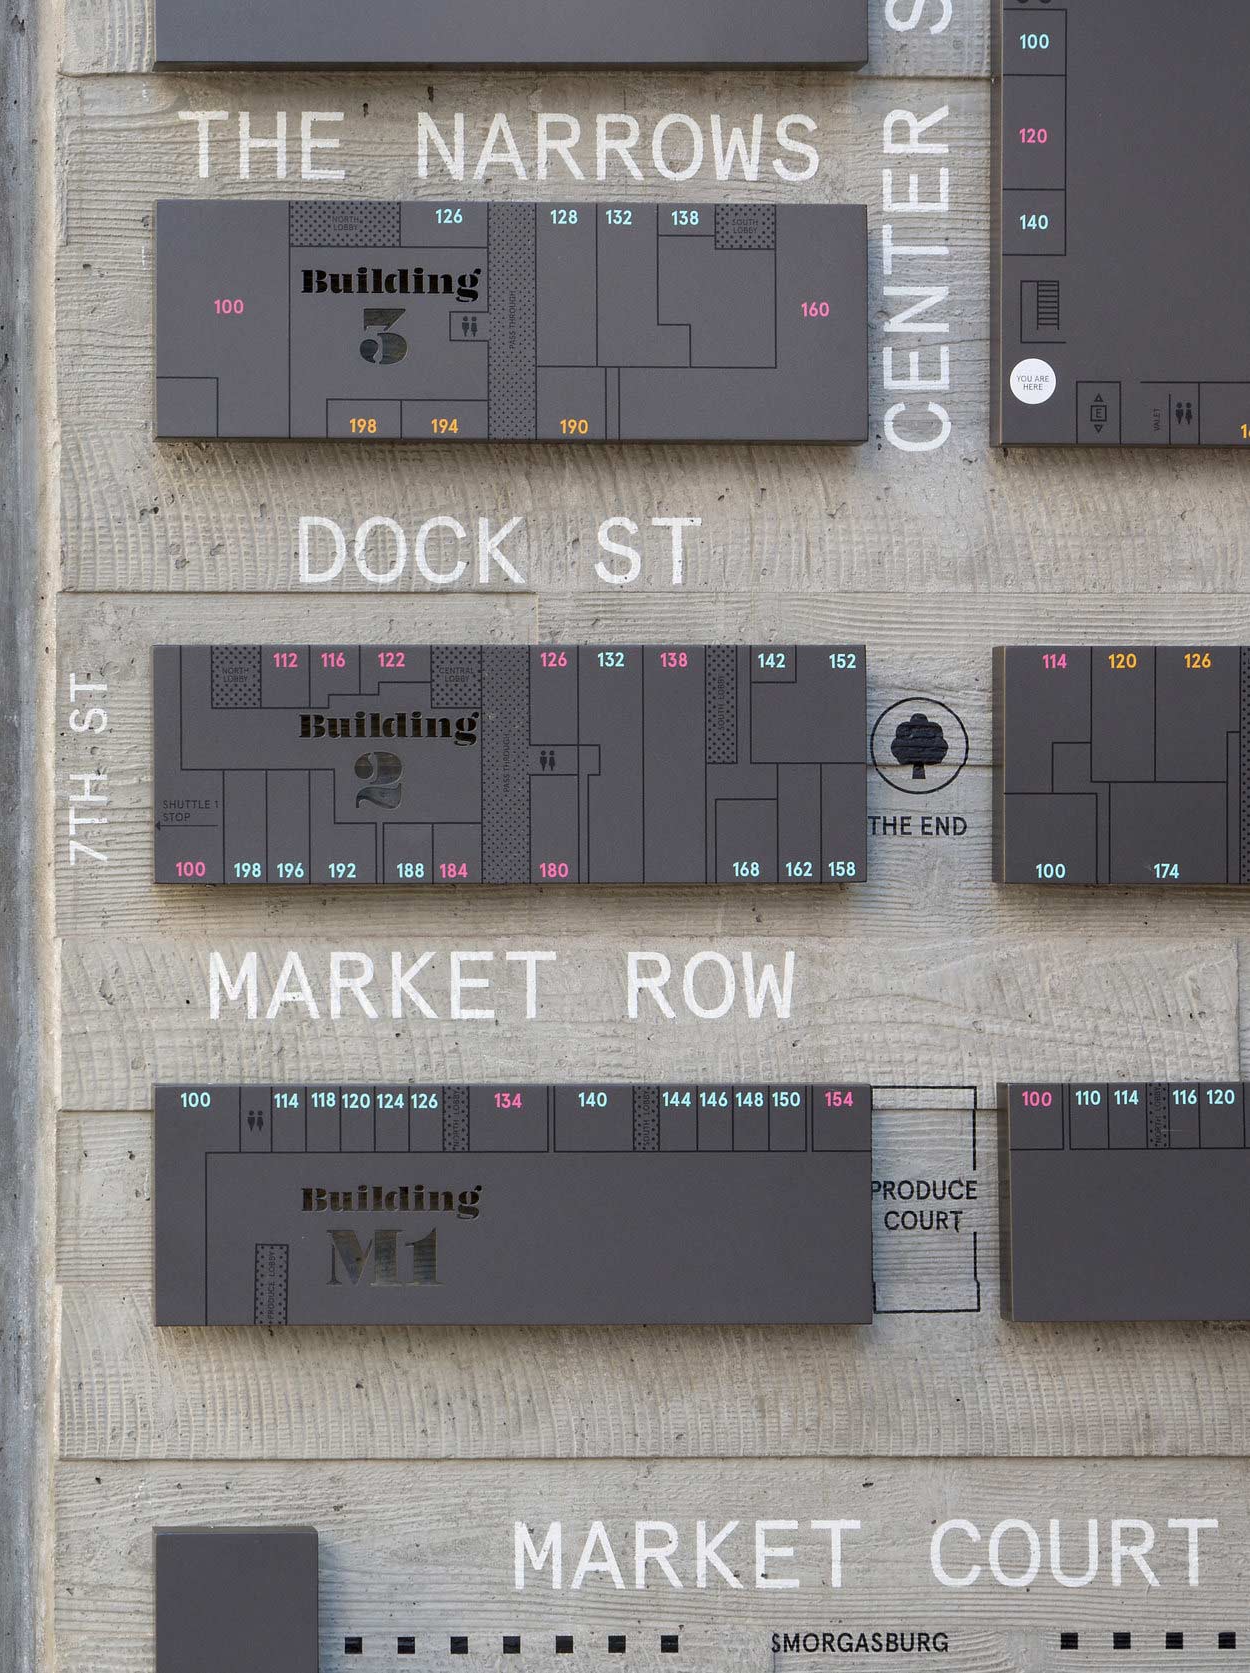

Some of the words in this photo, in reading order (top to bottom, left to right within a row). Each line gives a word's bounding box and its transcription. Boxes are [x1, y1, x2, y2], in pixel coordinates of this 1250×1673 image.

[1020, 33, 1050, 50] 100
[1019, 127, 1048, 144] 120
[178, 110, 346, 181] THE
[417, 112, 820, 182] NARROWS
[435, 208, 463, 224] 126
[550, 209, 578, 225] 128
[605, 209, 632, 225] 132
[671, 210, 699, 226] 138
[731, 218, 759, 226] SOUTH
[1020, 214, 1049, 230] 140
[301, 267, 482, 303] Building
[882, 105, 953, 452] CENTER
[213, 298, 245, 315] 100
[801, 301, 830, 318] 160
[359, 308, 408, 365] 3
[1016, 375, 1033, 383] YOU
[1034, 375, 1050, 383] ARE
[1022, 383, 1044, 391] HERE
[349, 417, 377, 434] 198
[431, 418, 459, 434] 194
[559, 418, 589, 435] 190
[1153, 408, 1161, 432] VALET
[298, 515, 526, 584] DOCK
[594, 516, 702, 585] ST
[273, 652, 298, 668] 112
[320, 652, 346, 668] 116
[378, 651, 406, 668] 122
[540, 651, 568, 668] 126
[597, 651, 625, 667] 132
[660, 651, 688, 668] 138
[758, 653, 786, 669] 142
[829, 653, 857, 669] 152
[1042, 653, 1067, 669] 114
[1108, 653, 1137, 669] 120
[1184, 652, 1212, 669] 126
[438, 666, 474, 675] CENTRAL
[69, 672, 108, 735] ST
[299, 711, 480, 747] Building
[354, 751, 403, 810] 2
[162, 799, 211, 810] SHUTTLE
[69, 772, 108, 866] 7TH
[162, 812, 191, 822] STOP
[867, 815, 912, 836] THE
[921, 816, 968, 836] END
[175, 861, 206, 877] 100
[233, 862, 262, 878] 198
[277, 862, 305, 879] 196
[328, 862, 357, 879] 192
[397, 862, 425, 879] 188
[439, 863, 468, 879] 184
[539, 862, 569, 878] 180
[733, 861, 760, 877] 168
[785, 861, 813, 877] 162
[829, 861, 856, 877] 158
[1037, 863, 1066, 877] 100
[1154, 863, 1180, 877] 174
[208, 950, 557, 1021] MARKET
[627, 950, 796, 1020] ROW
[180, 1091, 211, 1108] 100
[274, 1093, 299, 1109] 114
[311, 1092, 336, 1109] 118
[341, 1092, 371, 1109] 120
[376, 1092, 405, 1109] 124
[410, 1092, 439, 1109] 126
[494, 1092, 523, 1109] 134
[578, 1092, 608, 1107] 140
[662, 1091, 692, 1107] 144
[699, 1091, 728, 1108] 146
[735, 1091, 764, 1107] 148
[772, 1091, 801, 1107] 150
[824, 1091, 854, 1107] 154
[1021, 1090, 1052, 1107] 100
[1075, 1090, 1101, 1106] 110
[1114, 1089, 1139, 1105] 114
[1172, 1089, 1197, 1105] 116
[1206, 1089, 1235, 1105] 120
[870, 1179, 978, 1201] PRODUCE
[301, 1184, 483, 1220] Building
[883, 1210, 964, 1233] COURT
[326, 1227, 445, 1286] M1
[513, 1518, 861, 1590] MARKET
[930, 1518, 1219, 1589] COURT
[771, 1631, 949, 1653] SMORGASBURG
